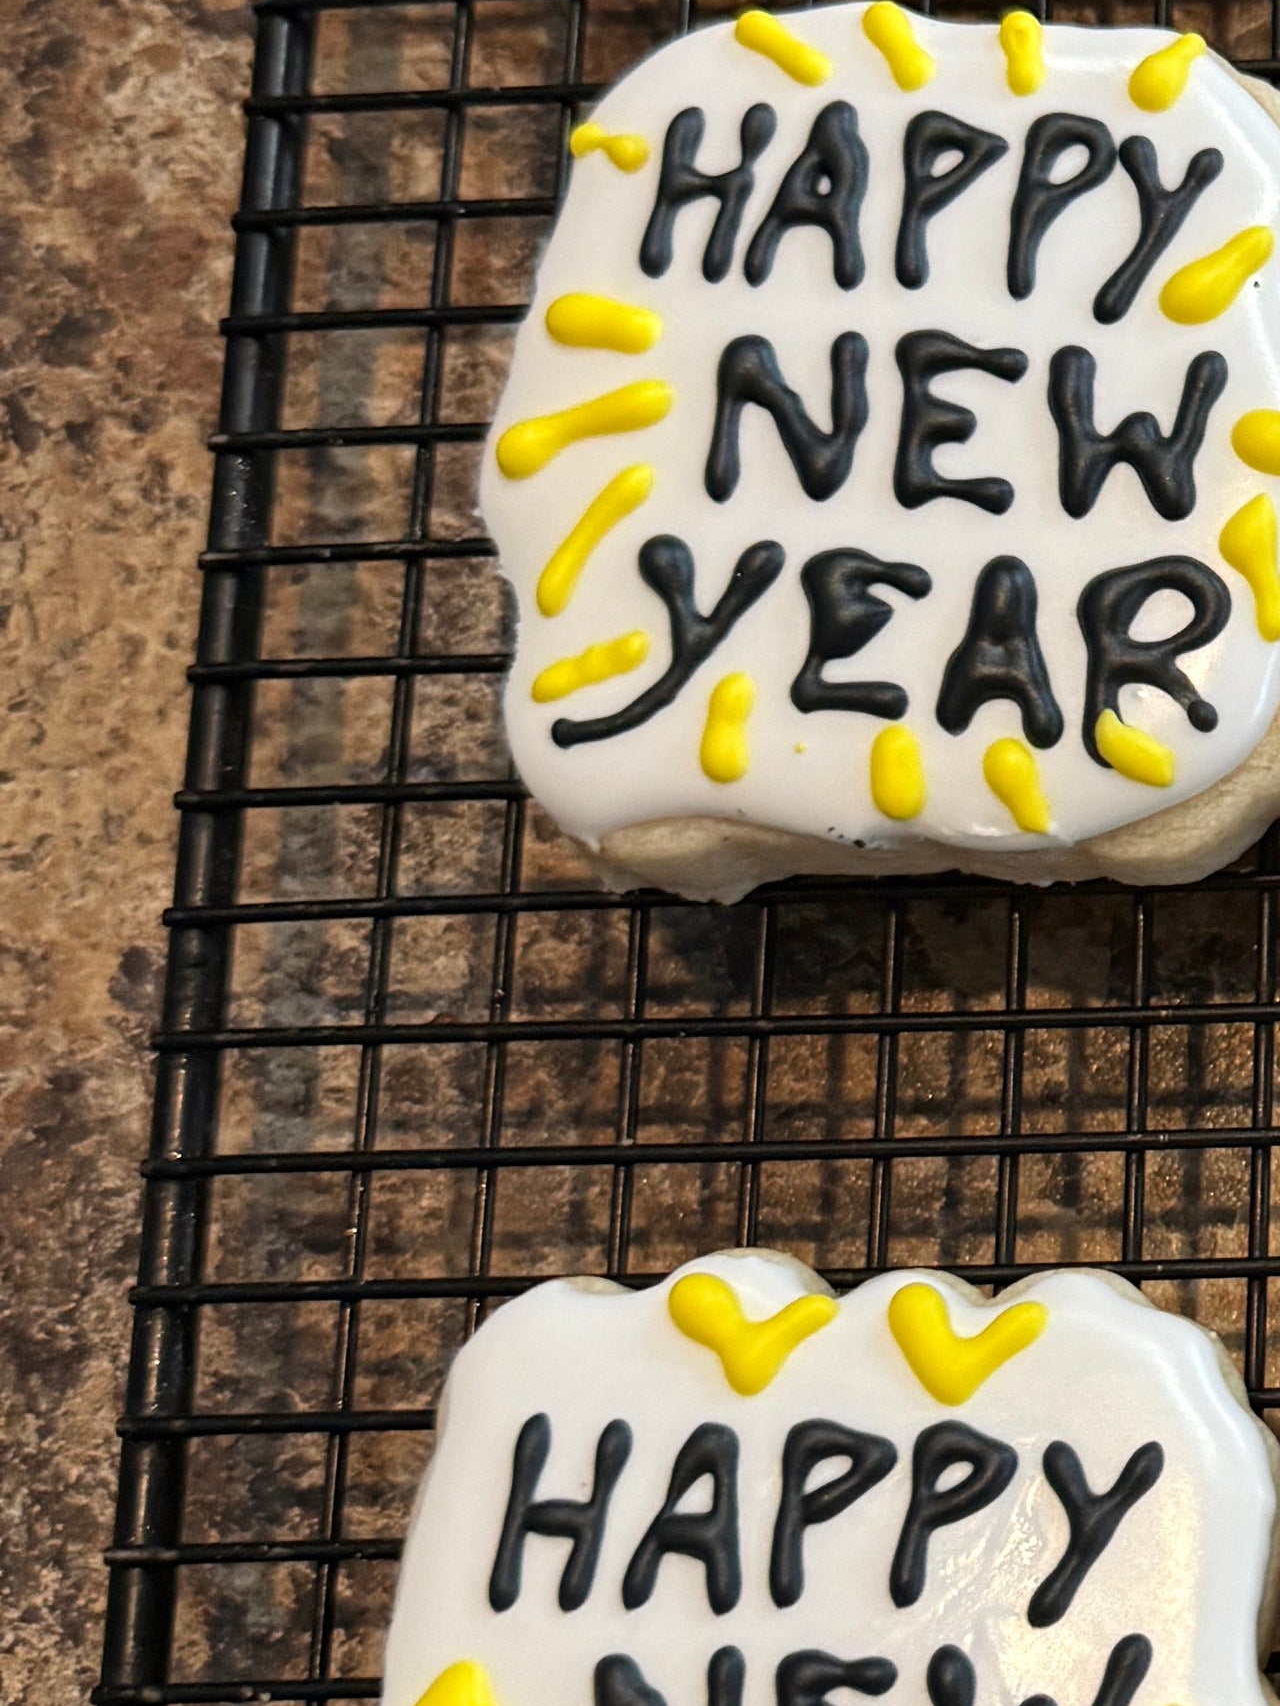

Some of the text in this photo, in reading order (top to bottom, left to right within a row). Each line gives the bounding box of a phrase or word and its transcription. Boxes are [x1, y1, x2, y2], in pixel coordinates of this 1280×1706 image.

[639, 101, 1222, 324] HAPPY
[704, 330, 1227, 521] NEW
[551, 535, 1231, 769] YEAR
[489, 1413, 1163, 1628] HAPPY
